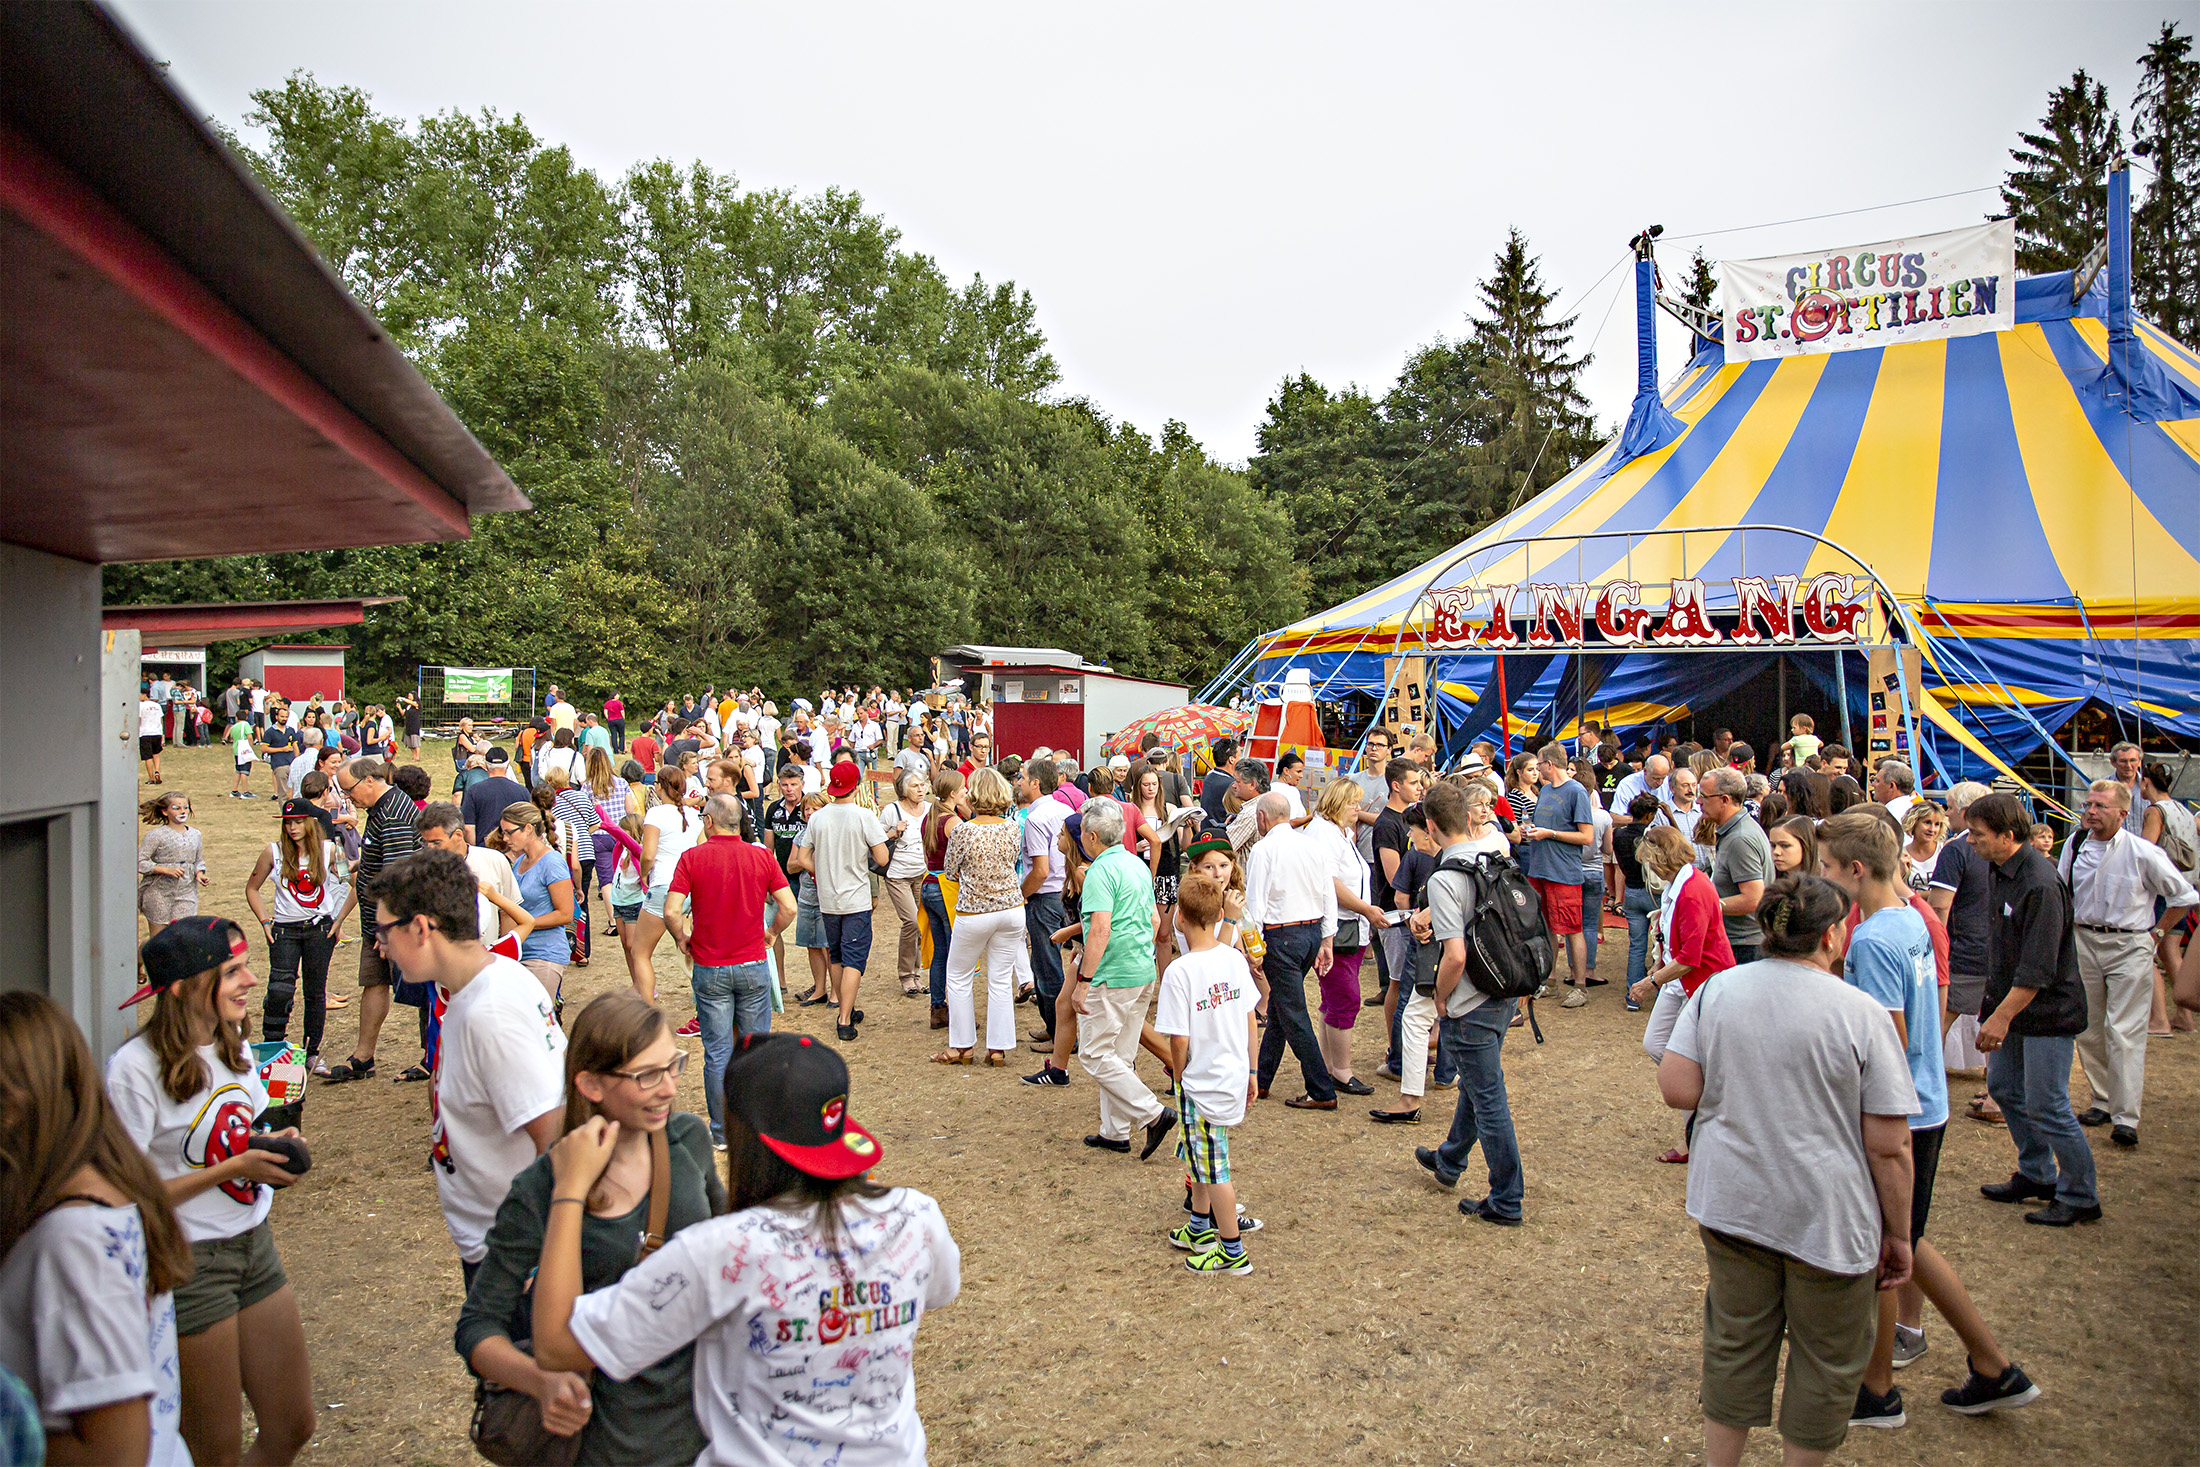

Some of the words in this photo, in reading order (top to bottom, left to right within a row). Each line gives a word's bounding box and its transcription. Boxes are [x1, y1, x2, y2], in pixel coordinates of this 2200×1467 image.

[1785, 252, 1927, 302] CIRCUS
[1736, 306, 1790, 342] ST.
[1426, 572, 1867, 648] EINGANG
[1024, 691, 1042, 699] KASSE
[867, 771, 893, 781] RESERVIER
[819, 1281, 892, 1314] CIRCUS
[776, 1319, 812, 1342] ST.
